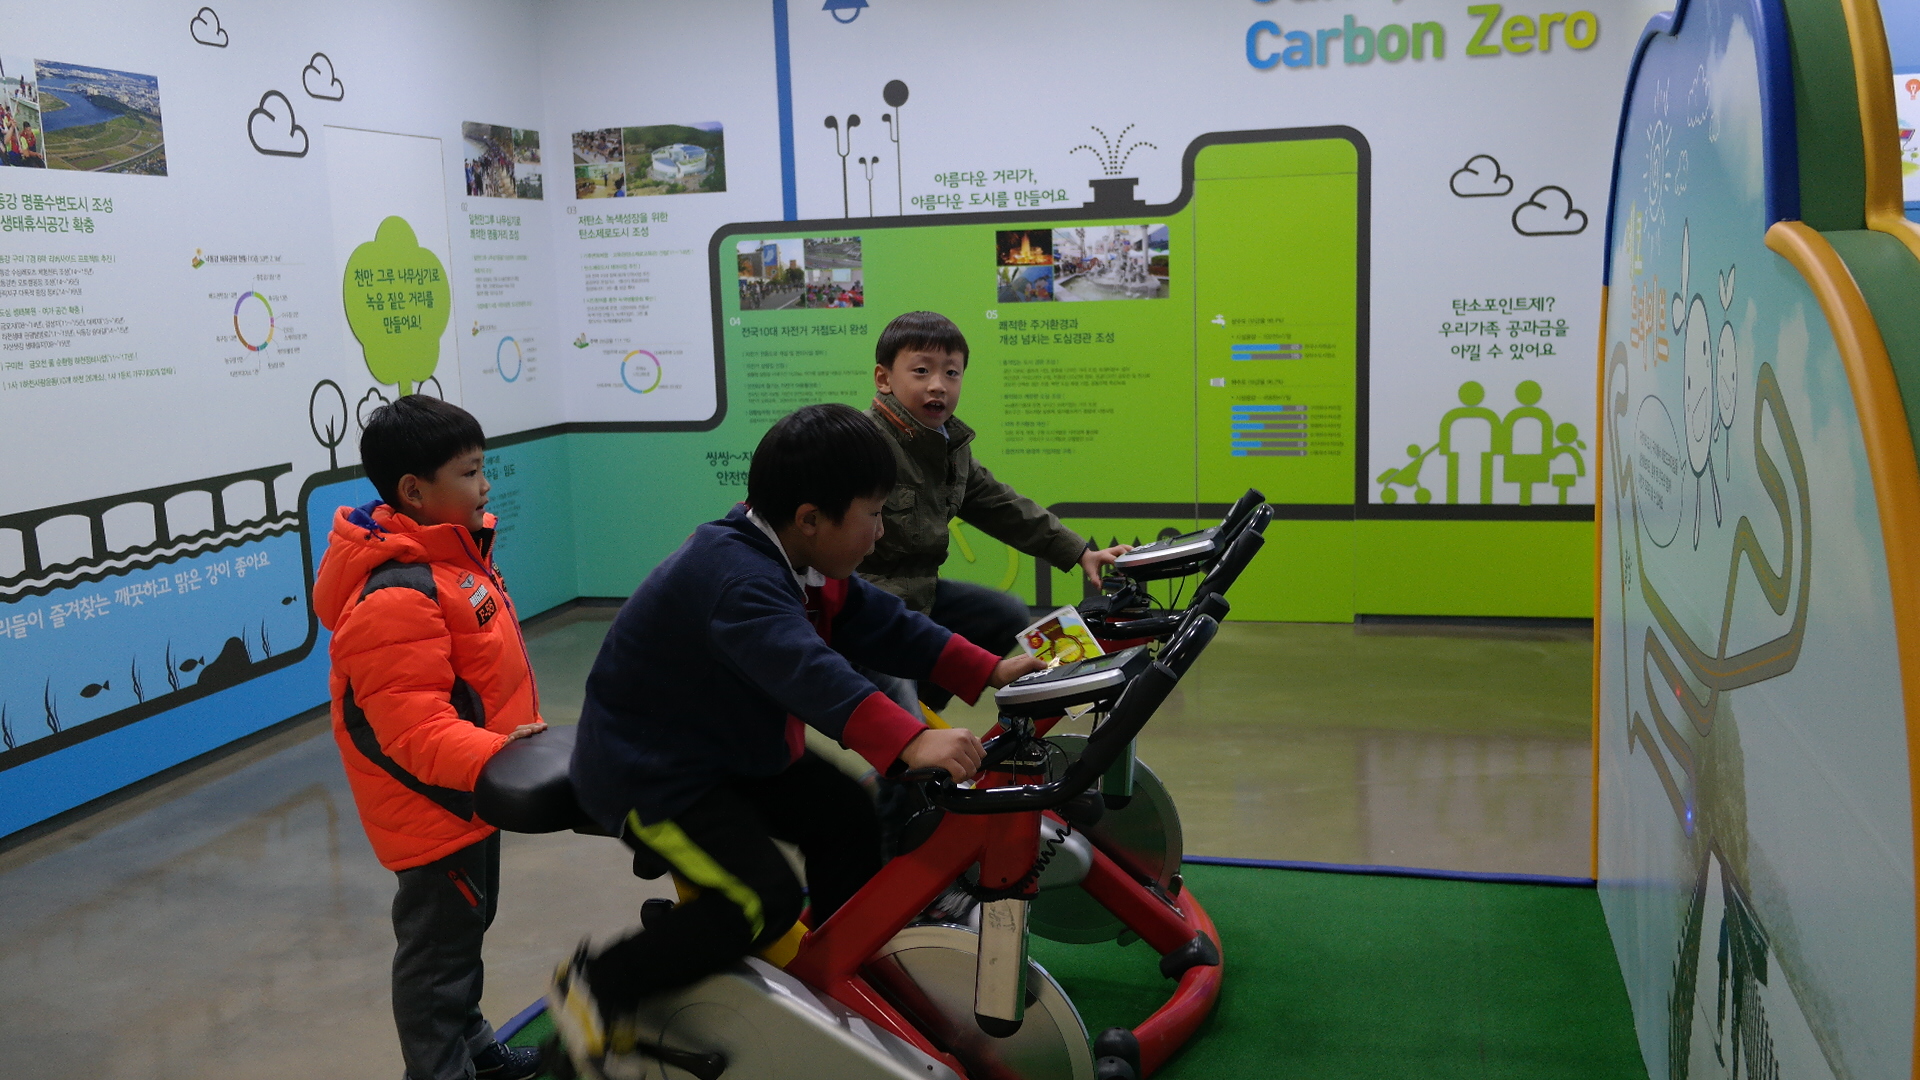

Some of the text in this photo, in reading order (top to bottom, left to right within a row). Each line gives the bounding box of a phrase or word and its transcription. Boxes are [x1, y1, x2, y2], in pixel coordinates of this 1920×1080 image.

[1245, 4, 1598, 70] Carbon Zero
[934, 168, 1038, 189] 아름다운 거리가,
[21, 194, 89, 213] 명품수변도시
[92, 197, 114, 214] 조성
[911, 189, 1070, 211] 아름다운 도시를 만들어요
[566, 206, 577, 215] 03
[578, 211, 669, 226] 저탄소 녹색성장을 위한
[0, 215, 95, 233] 생태휴식공간 확충
[578, 226, 650, 239] 탄소제로도시 조성
[509, 230, 520, 241] 조성
[354, 268, 441, 287] 천만 그루 나무심기로
[366, 291, 434, 311] 녹음 짙은 거리를
[1452, 297, 1555, 316] 탄소포인트제?
[383, 314, 422, 334] 만들어요!
[729, 317, 741, 326] 04
[986, 310, 998, 319] 05
[741, 323, 869, 338] 전국10대 자전거 거점도시 완성
[998, 318, 1079, 331] 쾌적한 주거환경과
[1438, 319, 1570, 338] 우리가족 공과금을
[999, 332, 1115, 346] 개성 넘치는 도심경관 조성
[1451, 342, 1556, 361] 아낄 수 있어요
[49, 594, 111, 629] 즐겨찾는
[115, 577, 172, 607] 깨끗하고
[174, 570, 203, 595] 맑은
[205, 560, 230, 586] 강이
[234, 551, 271, 578] 좋아요
